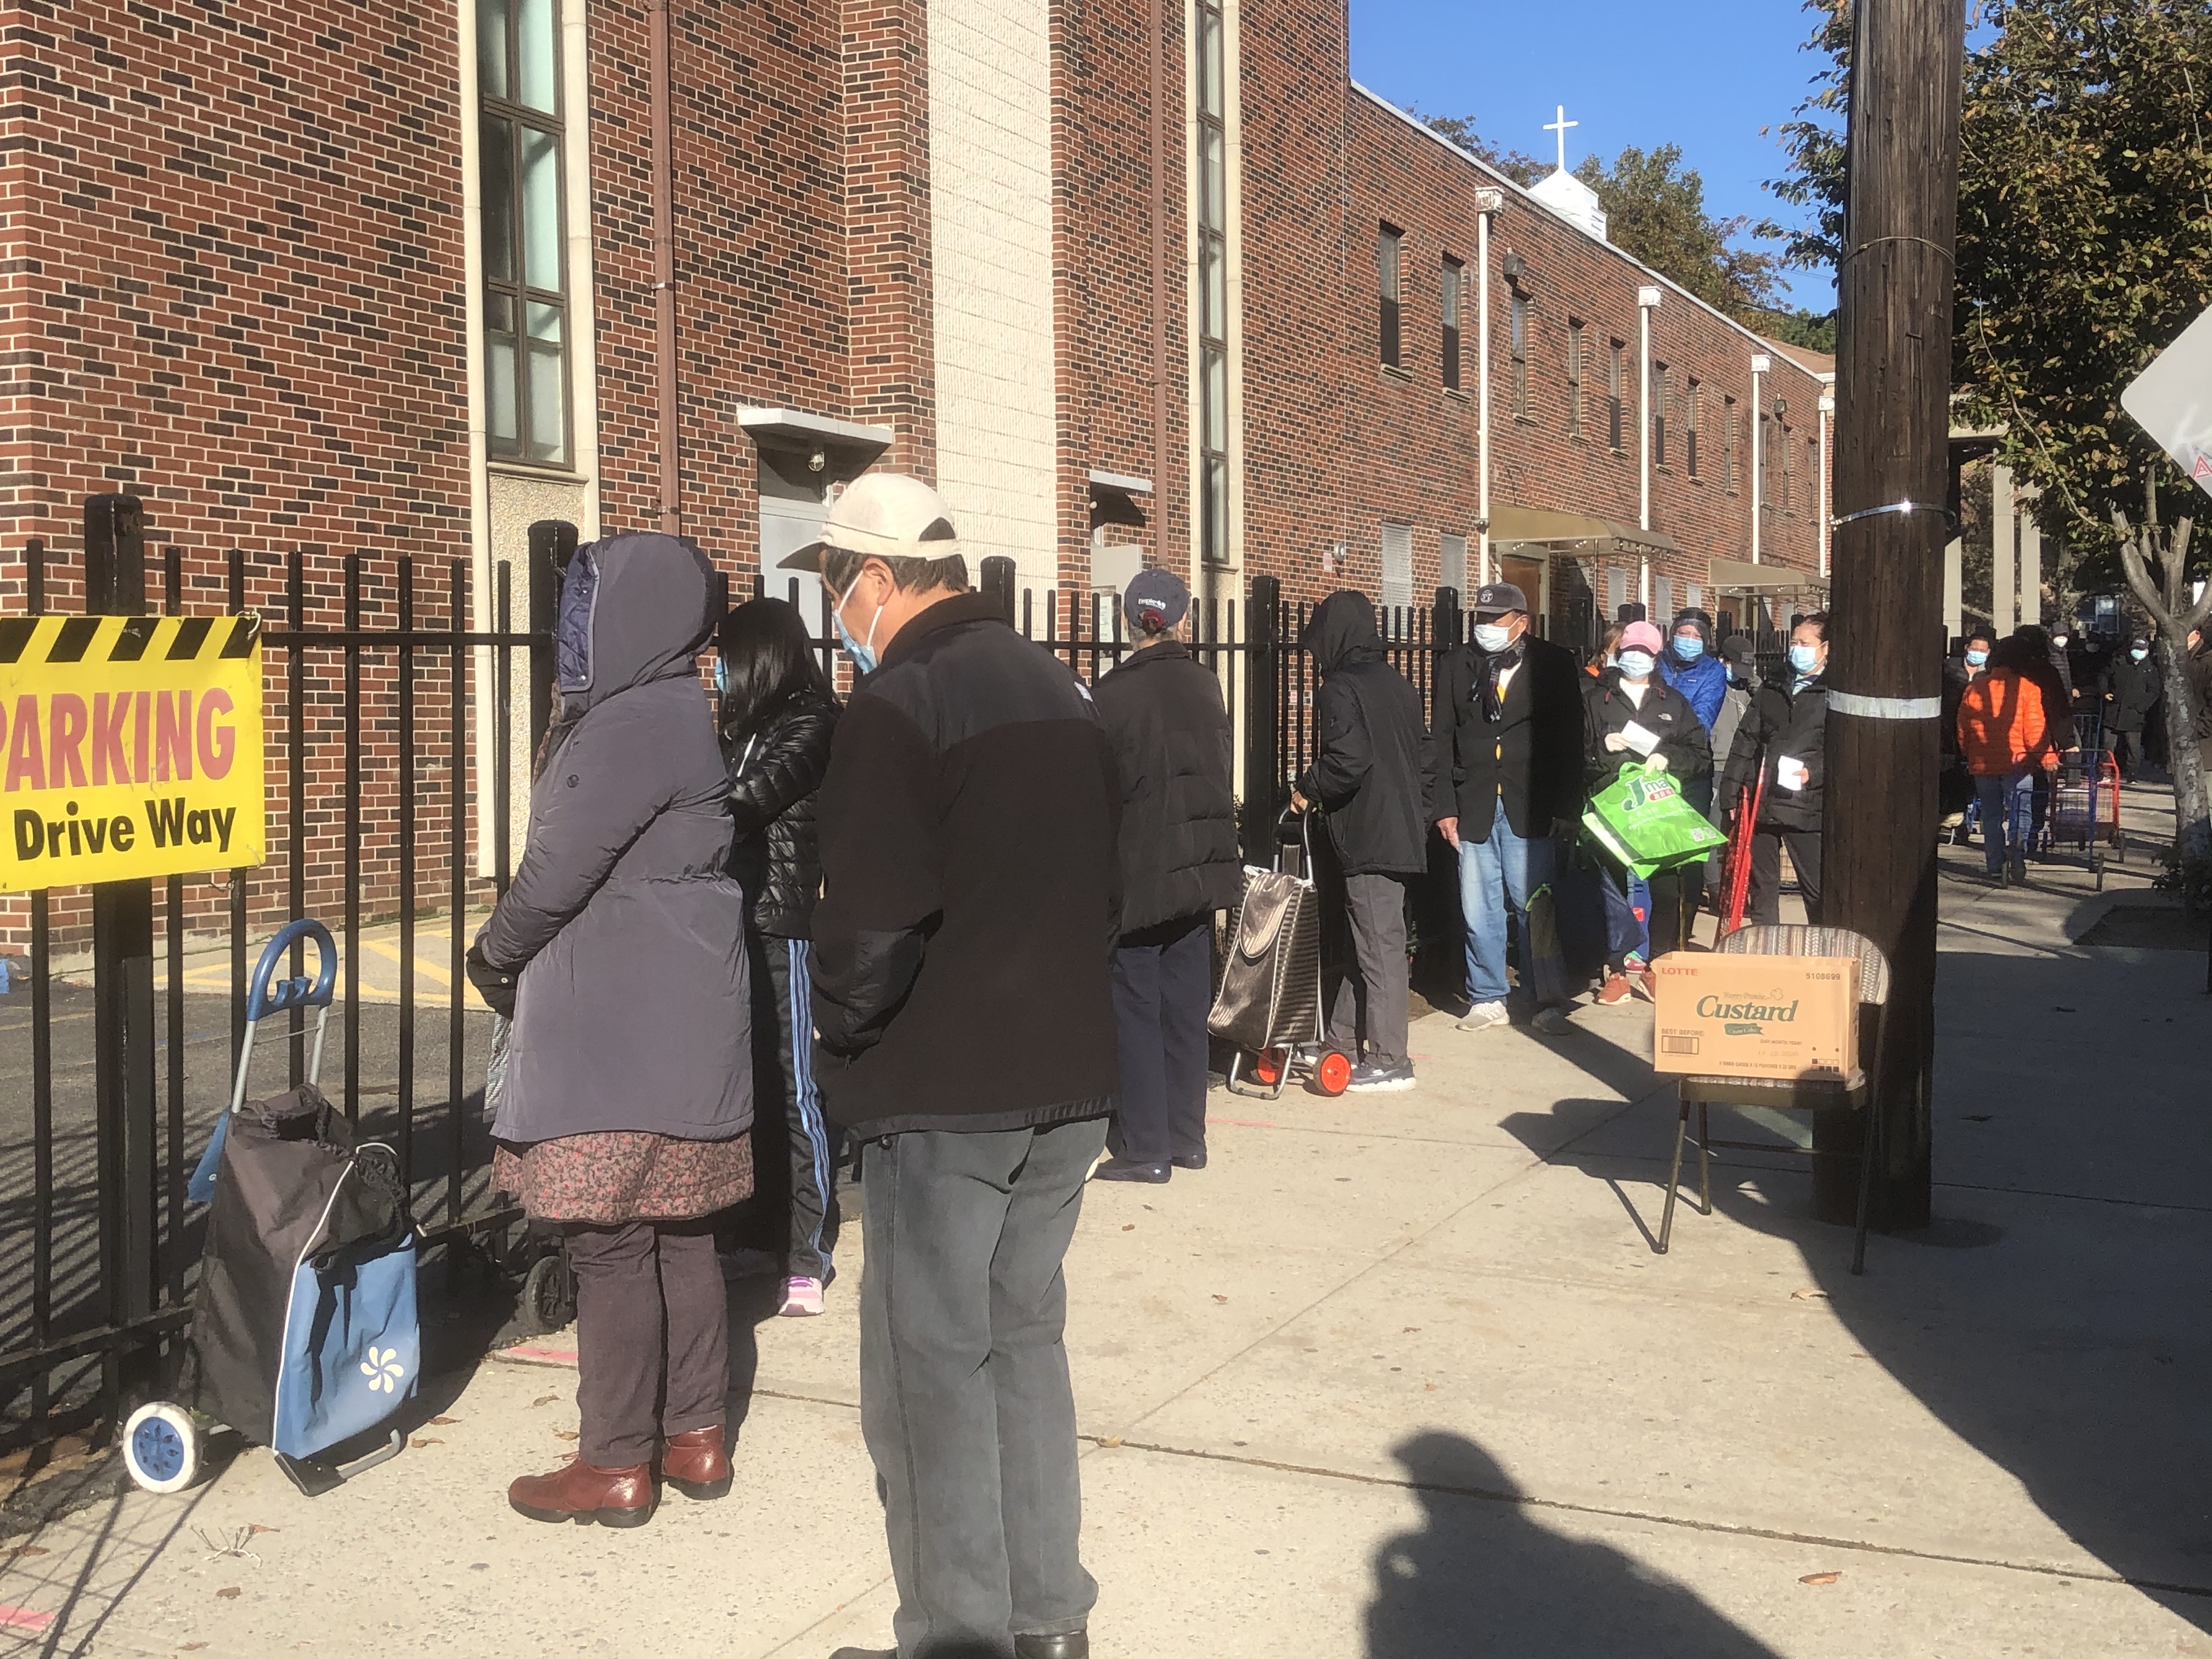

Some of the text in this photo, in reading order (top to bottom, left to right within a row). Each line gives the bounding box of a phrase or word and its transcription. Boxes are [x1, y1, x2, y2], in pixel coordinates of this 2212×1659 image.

[0, 687, 235, 792] ARKING
[14, 798, 237, 861] Drive Way
[1662, 967, 1698, 977] LOTTE
[1696, 995, 1799, 1022] Custard
